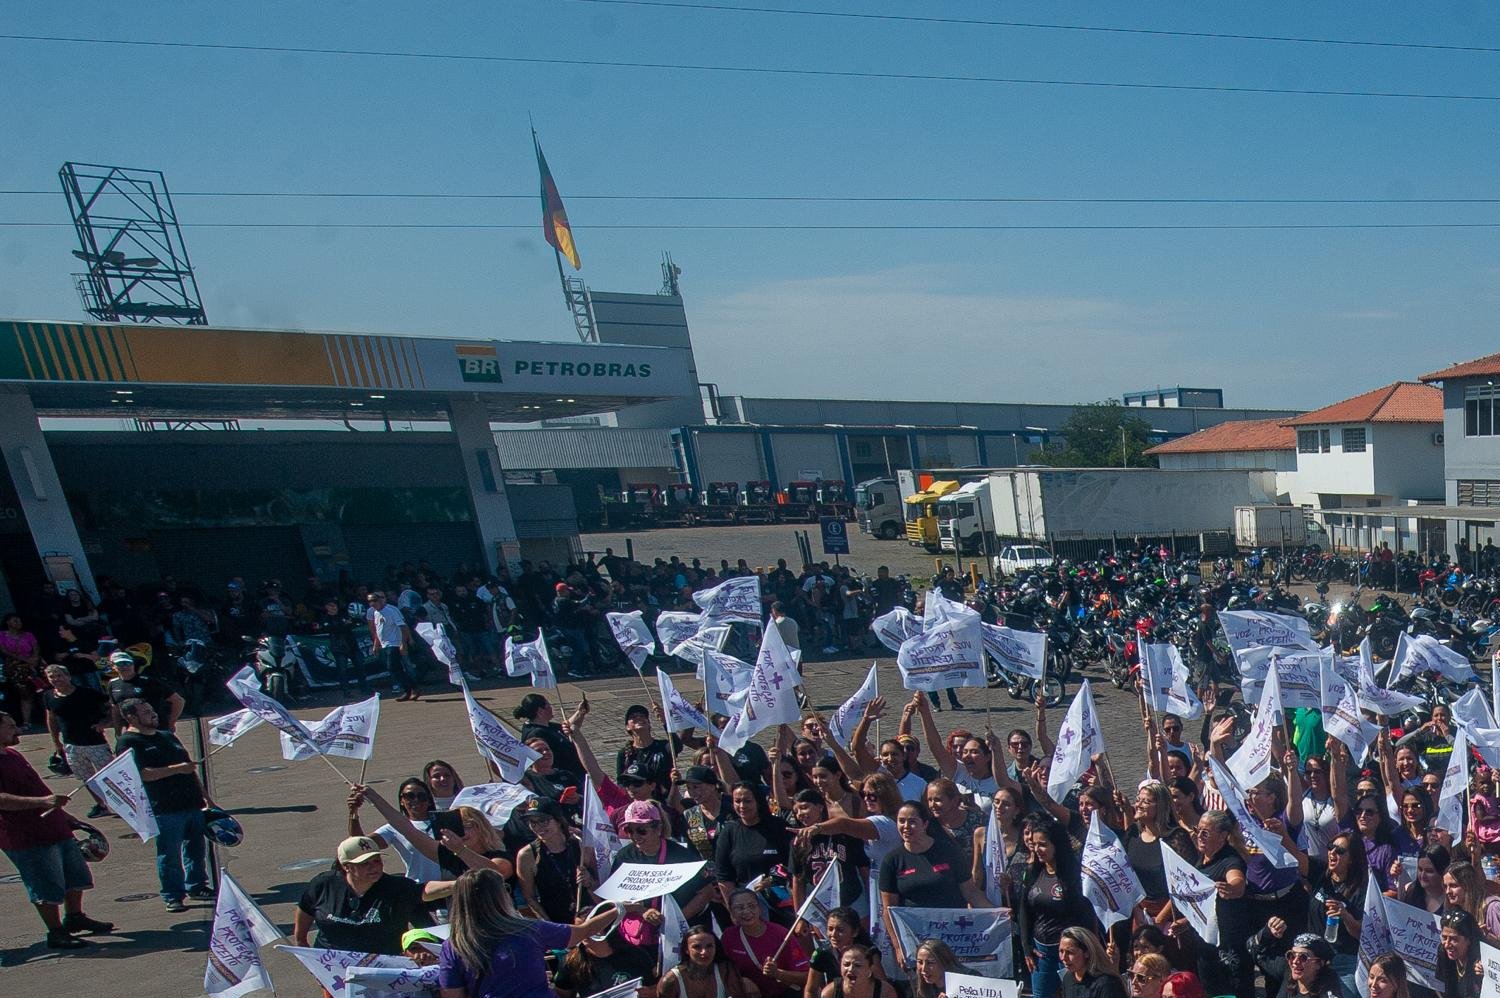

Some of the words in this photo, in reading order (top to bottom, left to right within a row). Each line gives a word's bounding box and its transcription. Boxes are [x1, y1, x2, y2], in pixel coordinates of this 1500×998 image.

[465, 359, 496, 375] BR
[514, 360, 651, 377] PETROBRAS
[1413, 933, 1439, 949] PROTE
[1488, 970, 1499, 982] QUE
[959, 985, 979, 996] Pela
[979, 988, 1002, 998] VIDA
